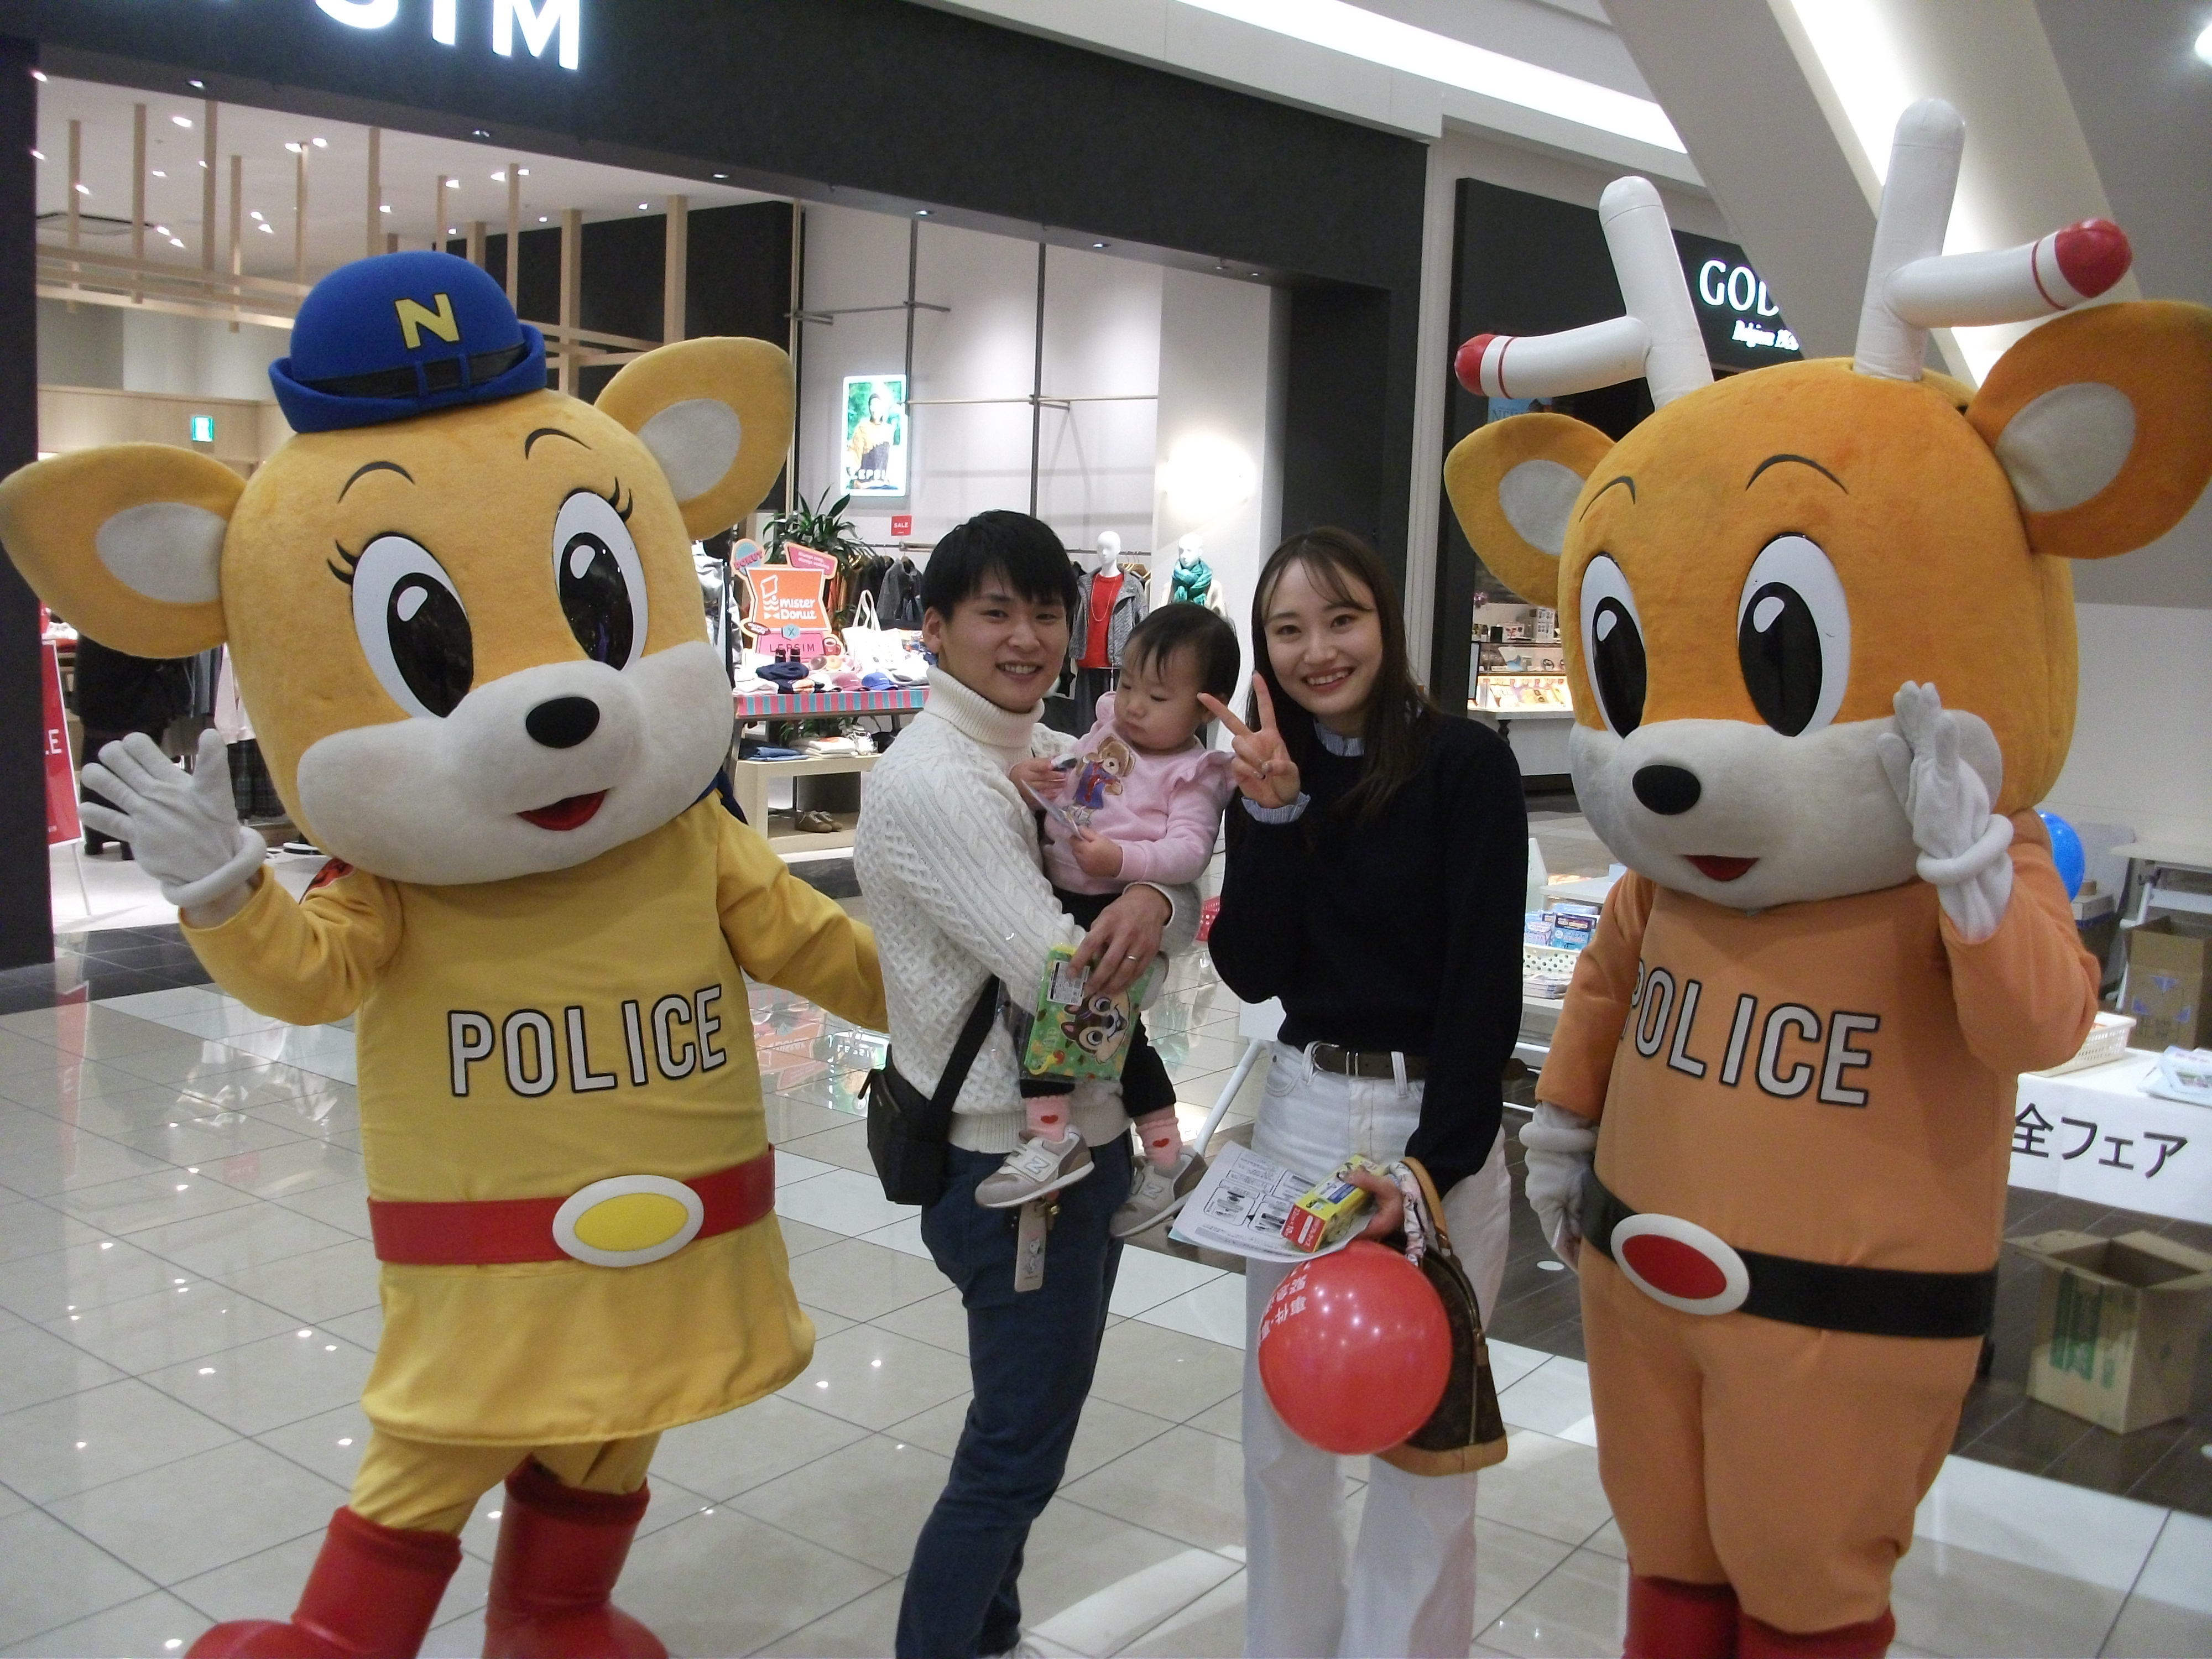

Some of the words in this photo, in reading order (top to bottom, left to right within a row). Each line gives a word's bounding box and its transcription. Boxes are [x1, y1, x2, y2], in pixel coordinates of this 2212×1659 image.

[394, 292, 460, 349] N
[780, 609, 817, 620] Donut
[45, 729, 62, 755] E
[447, 983, 727, 1097] POLICE
[2012, 1103, 2188, 1178] 全フェア
